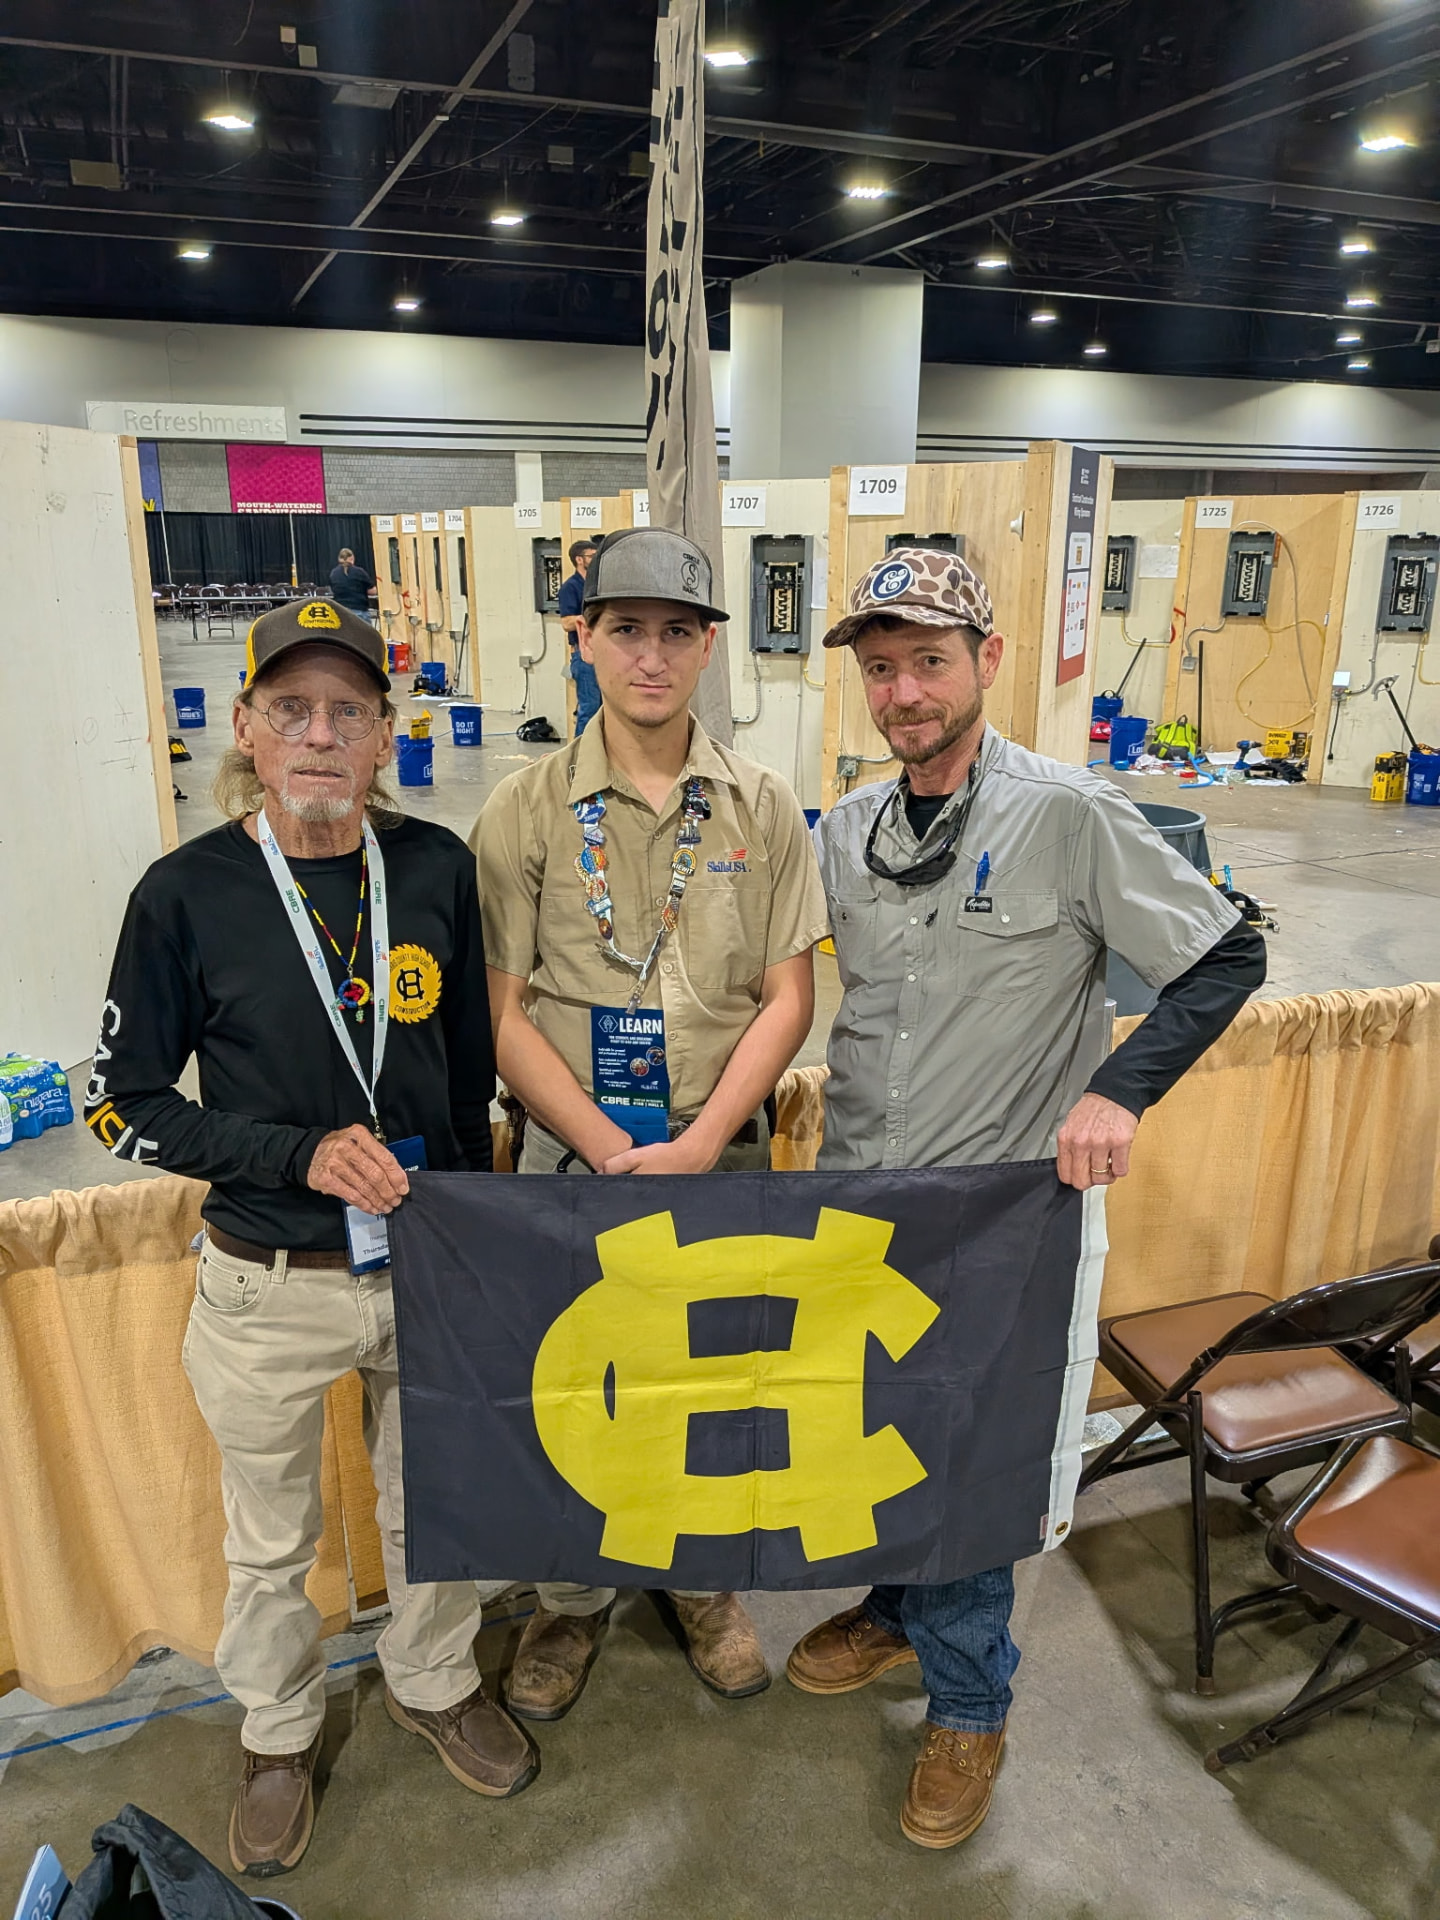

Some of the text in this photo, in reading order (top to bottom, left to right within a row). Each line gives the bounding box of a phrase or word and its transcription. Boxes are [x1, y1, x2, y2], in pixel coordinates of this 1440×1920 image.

[123, 409, 285, 435] Refreshments
[859, 479, 897, 494] 1709
[729, 498, 759, 510] 1707
[518, 509, 537, 518] 1705
[575, 507, 597, 517] 1706
[1202, 507, 1227, 517] 1725
[1364, 505, 1394, 516] 1726
[671, 861, 693, 874] KIEWIT
[374, 880, 382, 905] CBRE
[285, 888, 300, 913] CBRE
[619, 1017, 662, 1035] LEARN
[23, 1087, 63, 1110] niagara
[600, 1095, 630, 1106] CBRE
[363, 1244, 389, 1255] Thursda
